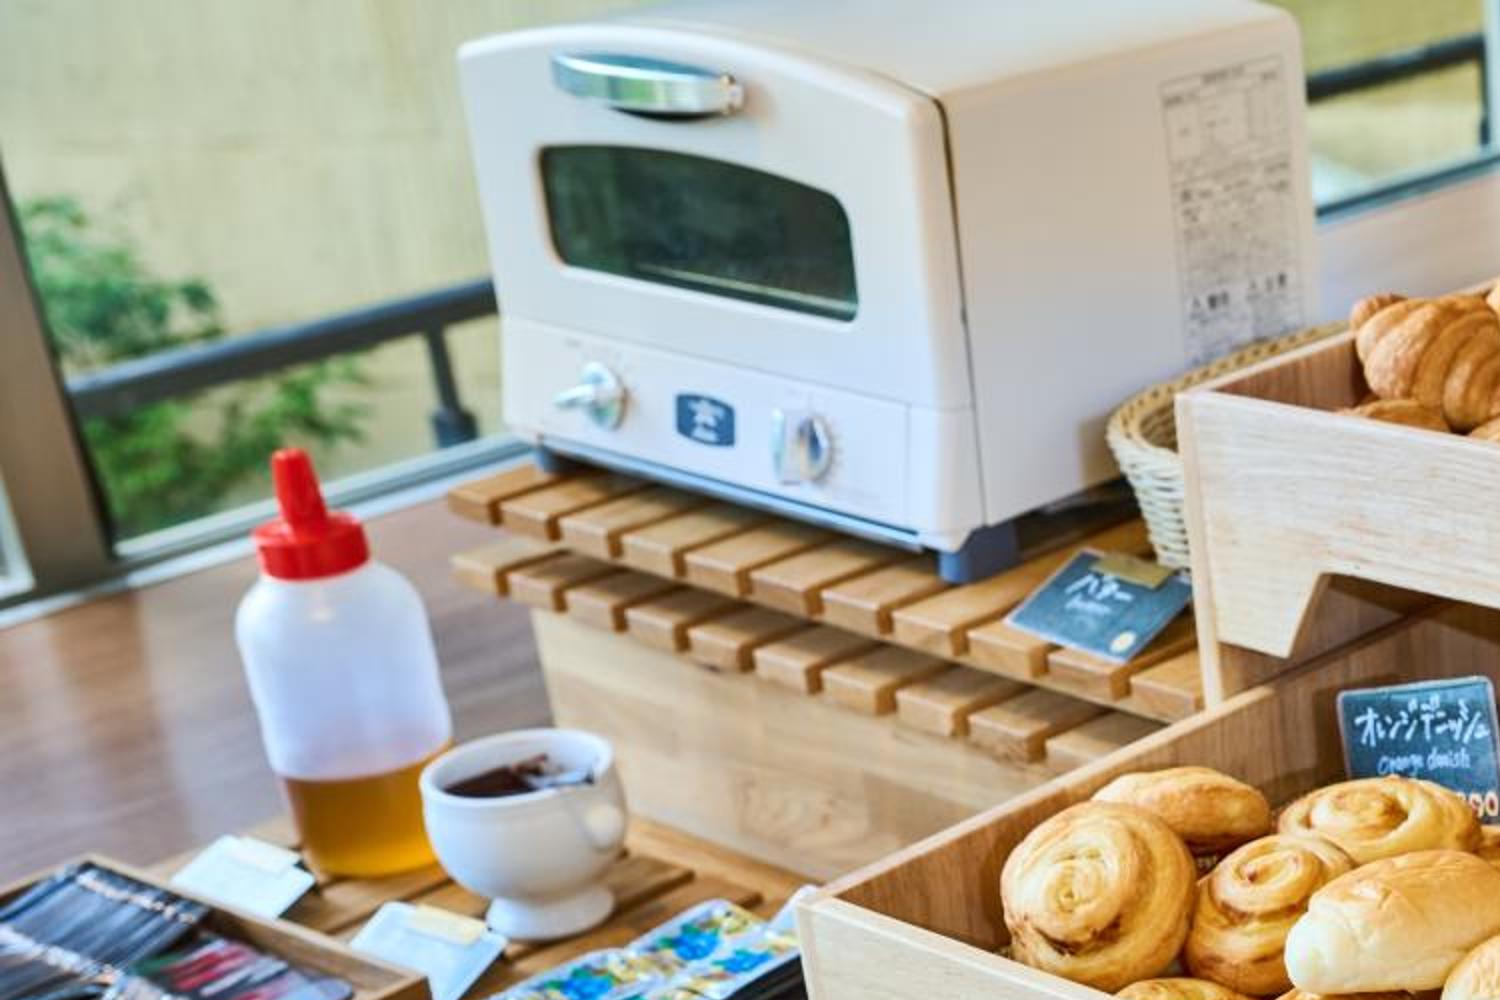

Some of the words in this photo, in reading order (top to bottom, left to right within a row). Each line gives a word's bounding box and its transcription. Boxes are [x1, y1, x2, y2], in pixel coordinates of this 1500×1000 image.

[1353, 693, 1491, 747] オレンジデニッシュ
